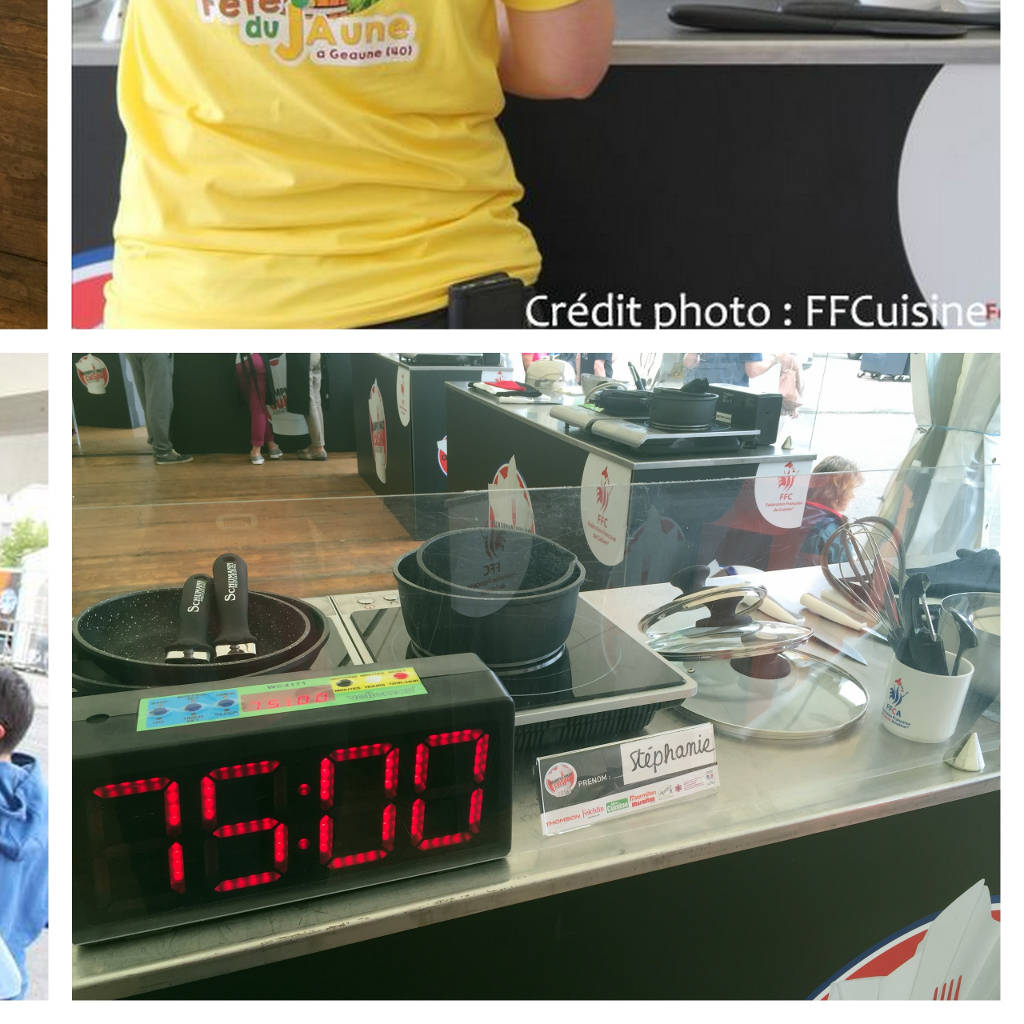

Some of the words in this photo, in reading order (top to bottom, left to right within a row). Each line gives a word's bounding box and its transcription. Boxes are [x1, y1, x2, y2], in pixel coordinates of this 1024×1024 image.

[245, 15, 280, 39] du
[779, 492, 793, 501] FFC
[629, 734, 715, 773] Stéphanie
[94, 728, 490, 894] 75:00
